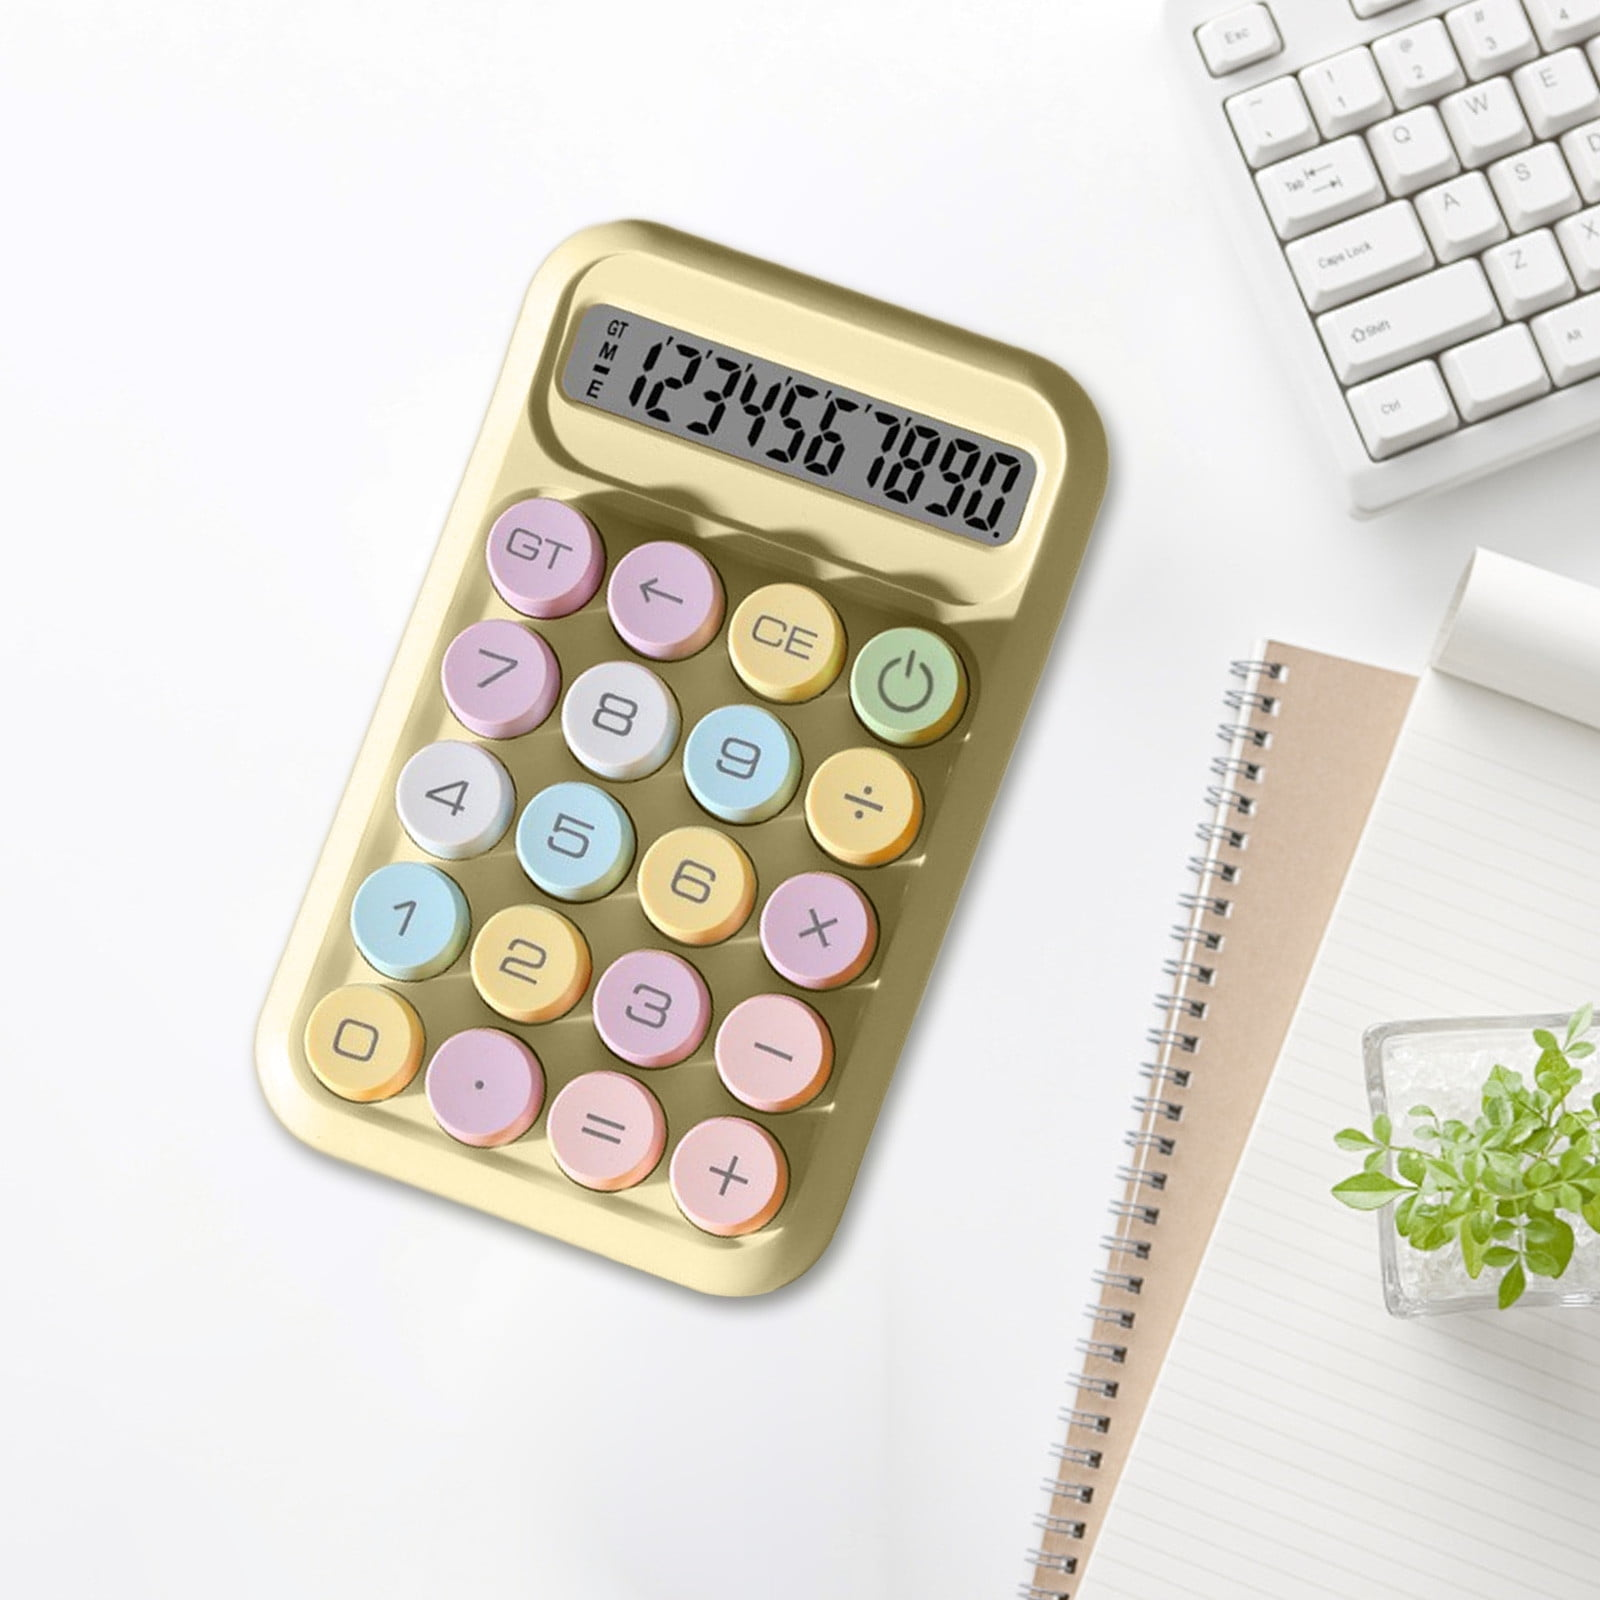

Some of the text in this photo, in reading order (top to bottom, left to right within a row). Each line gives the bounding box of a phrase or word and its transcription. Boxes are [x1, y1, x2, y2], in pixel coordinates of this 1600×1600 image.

[1223, 27, 1250, 45] Esc
[1485, 36, 1498, 51] 3
[1412, 64, 1425, 80] 2
[1539, 67, 1558, 88] E
[1463, 92, 1489, 115] W
[1392, 125, 1413, 145] Q
[1513, 162, 1532, 182] S
[1284, 179, 1304, 192] Tab
[1442, 191, 1463, 212] A
[1581, 219, 1600, 241] X
[1318, 241, 1374, 269] Caps Lock
[1508, 248, 1529, 270] Z
[607, 319, 629, 339] GT
[1365, 319, 1391, 337] Shift
[1565, 328, 1584, 343] Alt
[598, 341, 619, 362] M
[586, 379, 604, 399] E
[1380, 399, 1402, 415] Ctrl
[506, 527, 573, 570] GT
[751, 614, 818, 660] CE
[477, 648, 518, 688] 7
[591, 692, 638, 737] 8
[716, 737, 762, 780] 9
[424, 780, 469, 817] 4
[547, 812, 595, 859] 5
[670, 859, 716, 904] 6
[393, 900, 417, 937] 1
[499, 938, 547, 985] 2
[625, 983, 672, 1029] 3
[332, 1018, 379, 1062] 0
